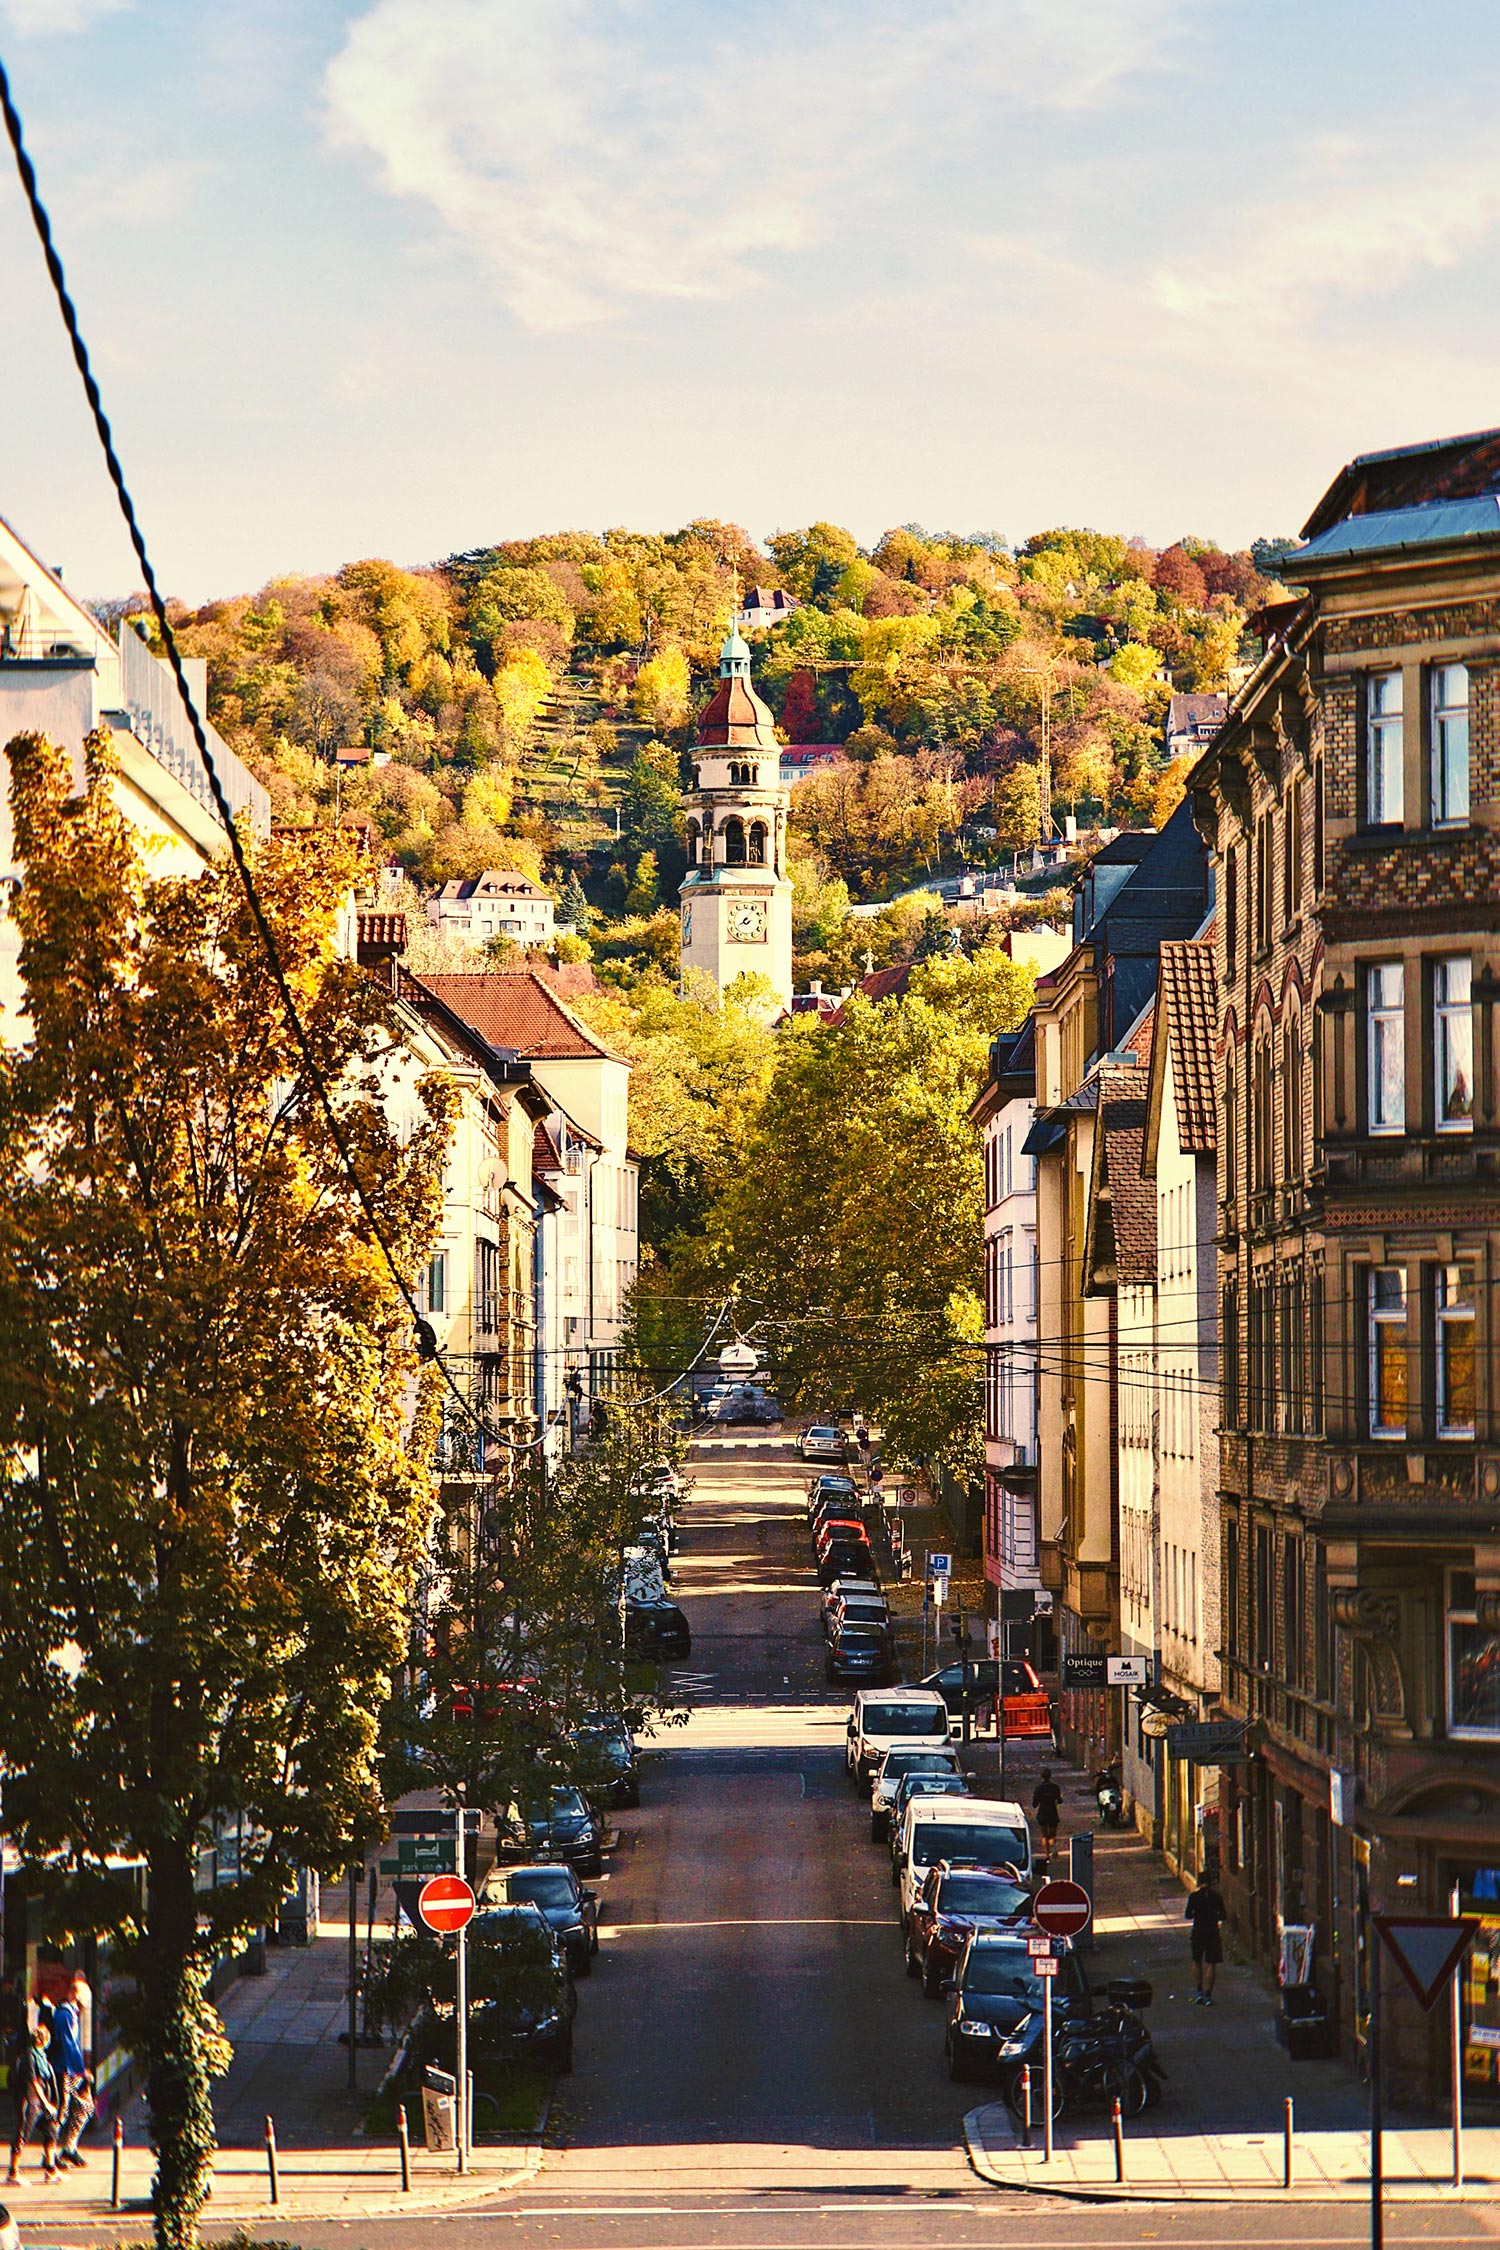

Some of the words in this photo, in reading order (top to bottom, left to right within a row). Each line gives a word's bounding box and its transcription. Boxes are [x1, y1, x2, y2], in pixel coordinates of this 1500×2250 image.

[937, 1558, 945, 1568] P
[1067, 1658, 1104, 1669] Optique
[402, 1861, 420, 1872] park
